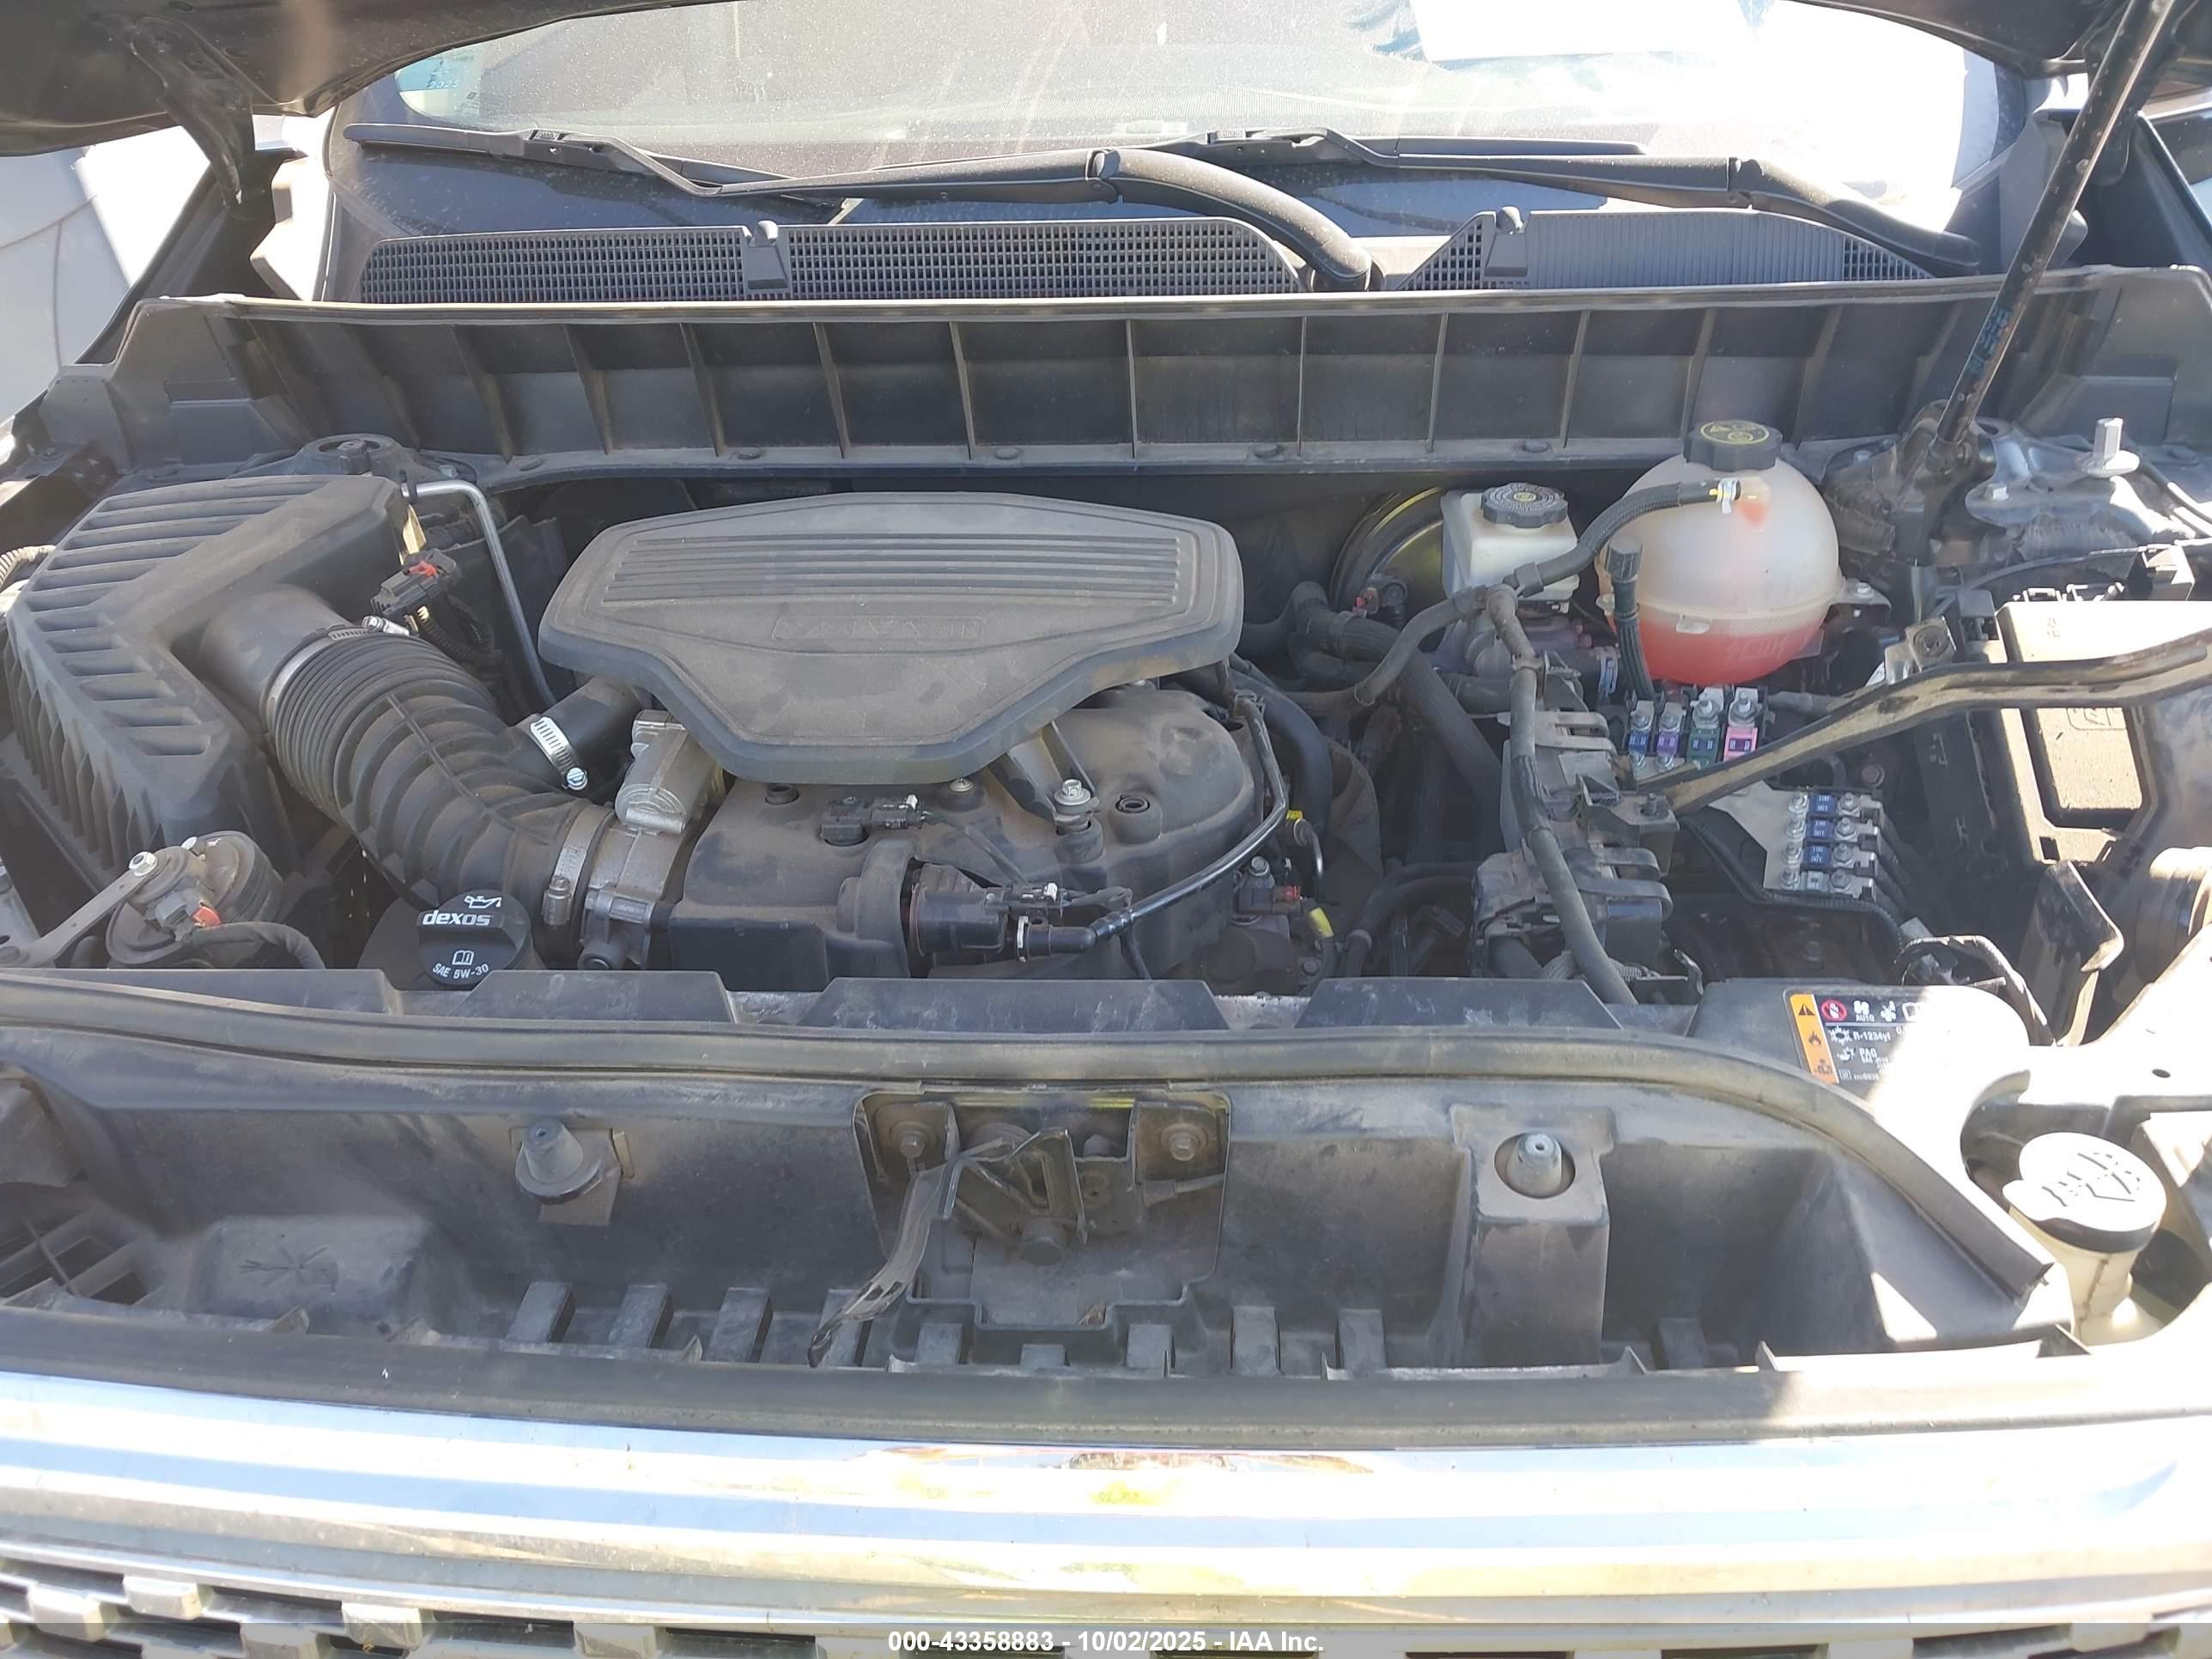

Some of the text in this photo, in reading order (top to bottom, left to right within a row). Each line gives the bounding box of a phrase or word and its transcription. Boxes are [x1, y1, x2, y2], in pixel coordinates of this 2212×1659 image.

[422, 910, 491, 927] dexos
[432, 963, 489, 979] SAE 5W-30
[1855, 1013, 1875, 1023] AUTO
